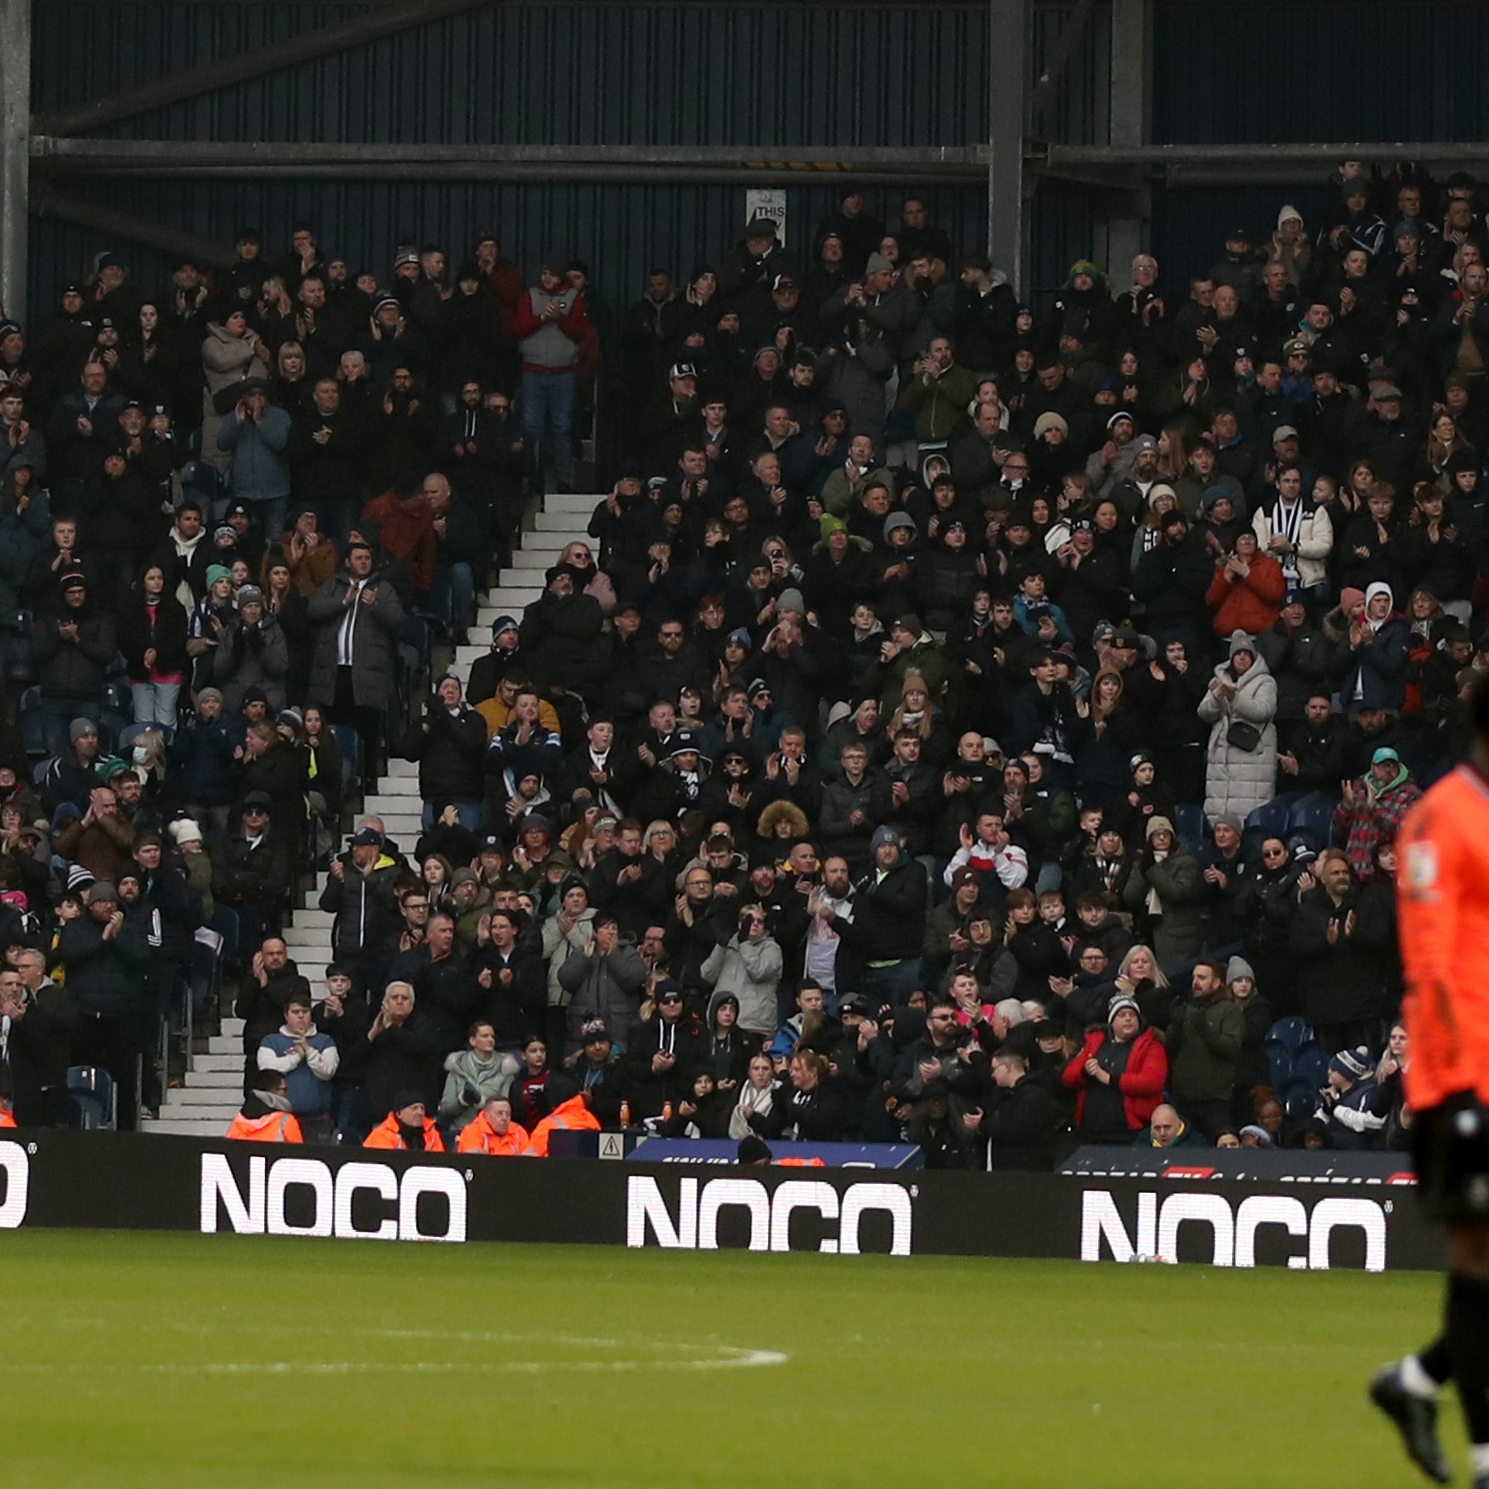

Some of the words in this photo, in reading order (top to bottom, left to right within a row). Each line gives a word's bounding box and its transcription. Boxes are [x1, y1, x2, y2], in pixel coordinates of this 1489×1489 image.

[757, 206, 785, 217] THIS
[201, 1152, 467, 1242] NOCO
[627, 1175, 912, 1256] NOCO
[1080, 1190, 1387, 1272] NOCO
